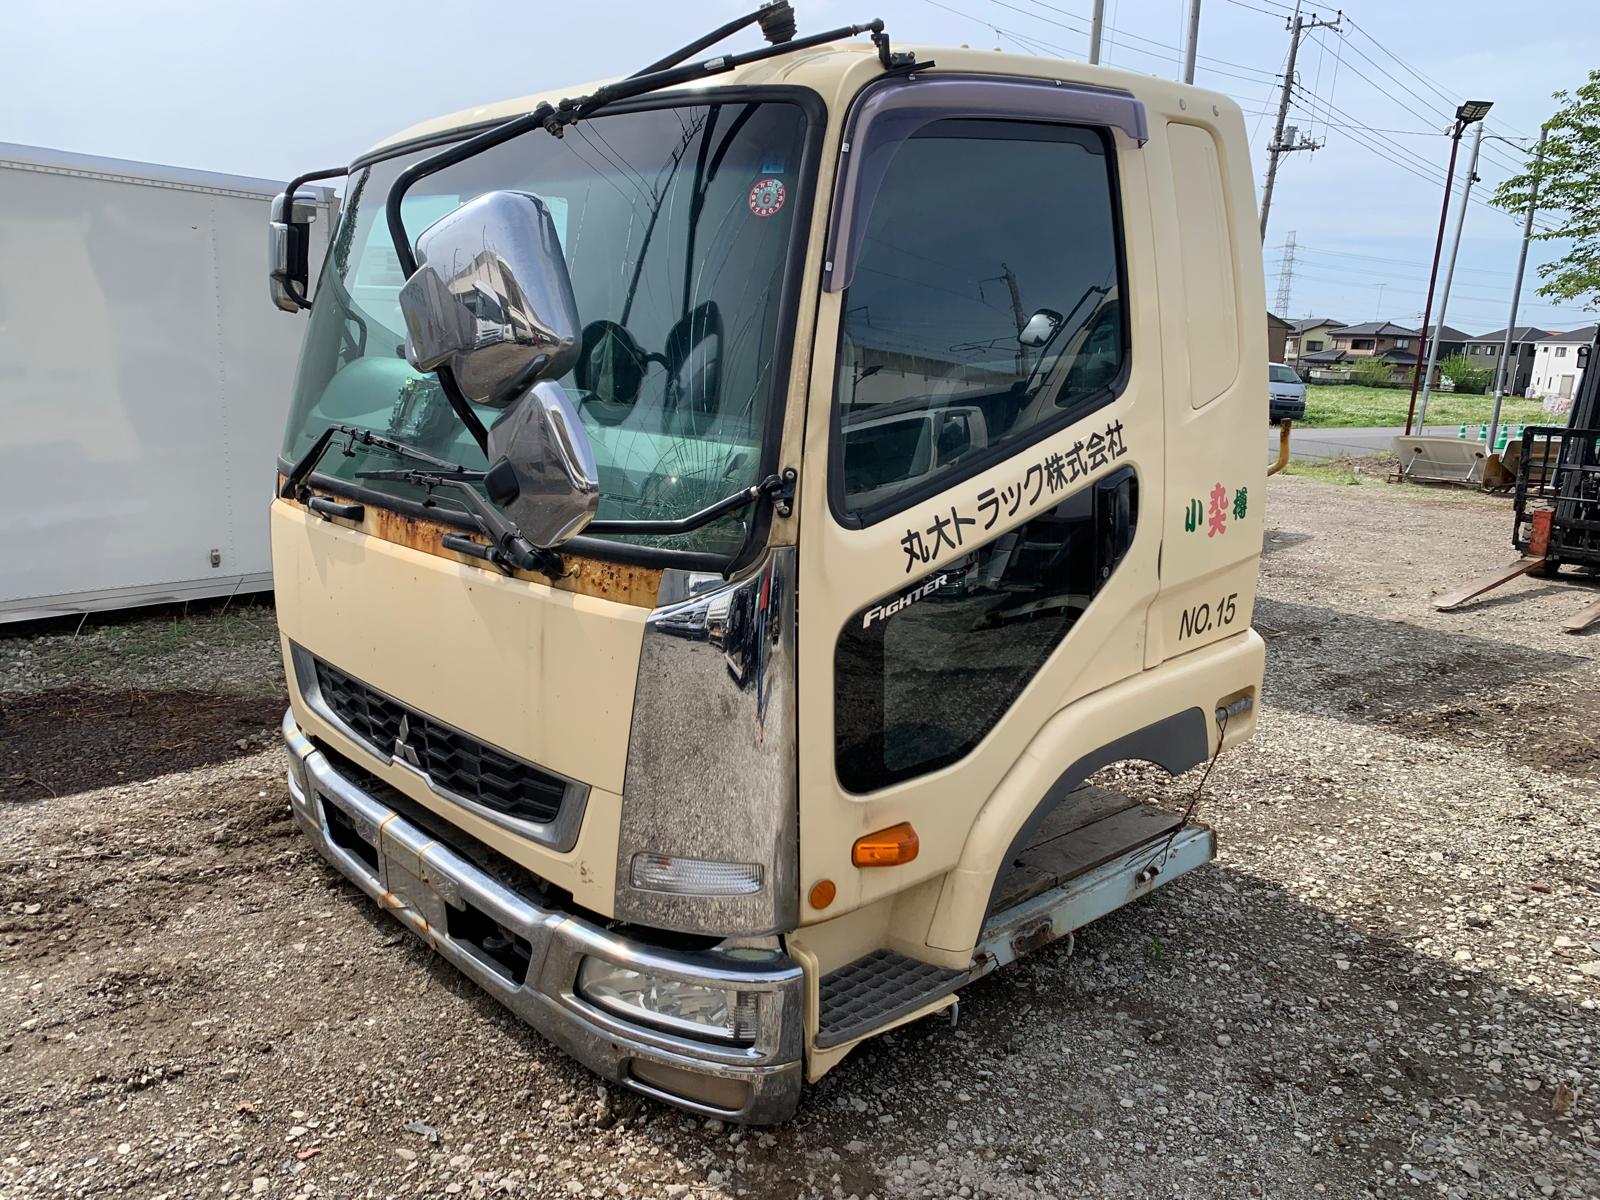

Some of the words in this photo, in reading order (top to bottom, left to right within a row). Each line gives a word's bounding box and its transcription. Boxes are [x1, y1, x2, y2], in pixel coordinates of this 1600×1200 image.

[763, 193, 771, 204] 6
[901, 419, 1128, 573] 丸大トラック株式会社
[1184, 498, 1203, 533] 小
[862, 573, 948, 629] FIGHTER
